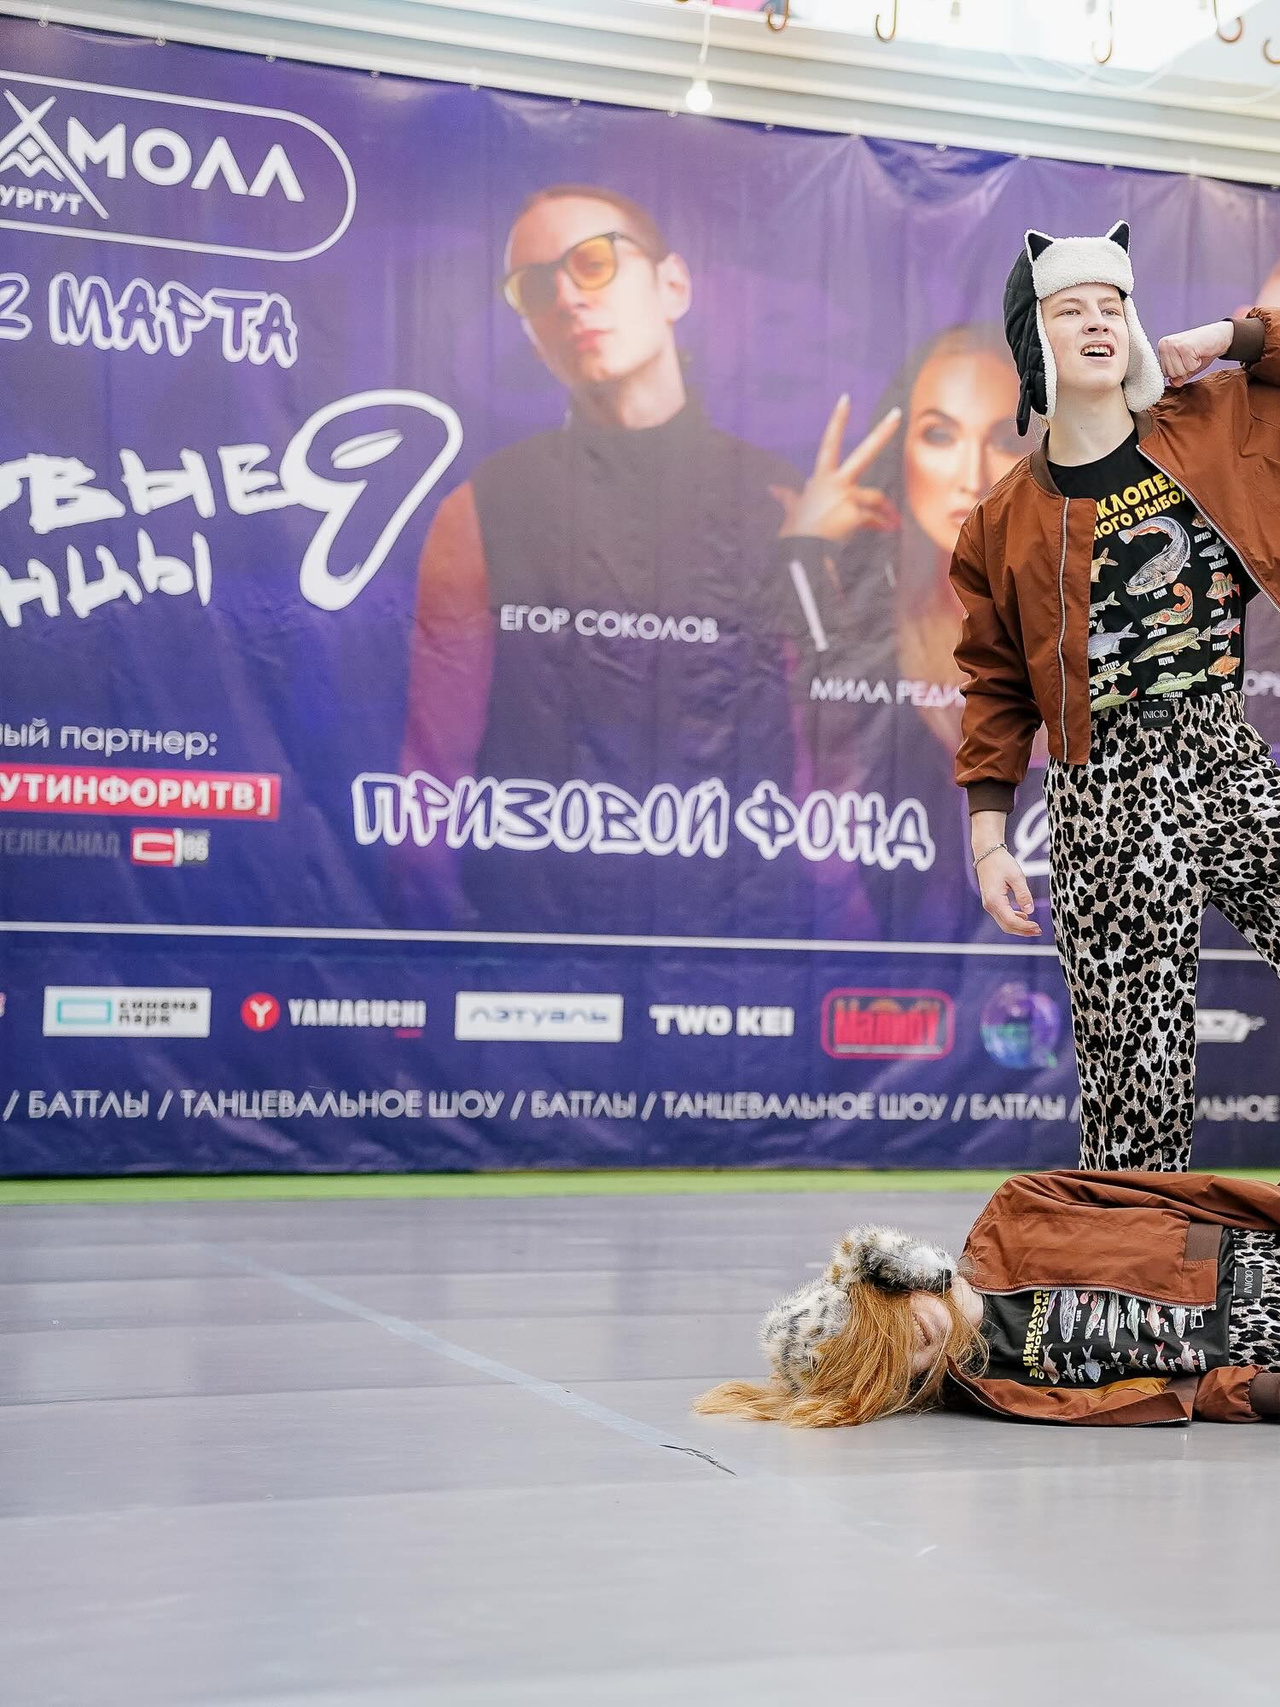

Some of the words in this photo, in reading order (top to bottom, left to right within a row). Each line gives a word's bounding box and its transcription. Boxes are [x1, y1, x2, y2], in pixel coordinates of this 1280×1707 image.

[67, 115, 305, 202] МОЛЛ
[48, 271, 299, 369] МАРТА
[1096, 472, 1176, 521] КЛОПЕ
[1152, 587, 1168, 600] СОМ
[500, 603, 571, 634] ЕГОР
[574, 608, 720, 644] СОКОЛОВ
[809, 675, 893, 705] МИЛА
[1142, 709, 1169, 720] INICIO
[0, 717, 50, 749] ый
[60, 725, 219, 762] партнер:
[352, 770, 730, 859] ПРИЗОВОЙ
[734, 778, 937, 871] ФОНД
[288, 998, 426, 1027] YAMAGUCHI
[649, 1005, 732, 1036] TWO
[28, 1090, 149, 1119] БАТТЛЫ
[181, 1090, 422, 1121] ТАНЦЕВАЛЬНОЕ
[429, 1090, 504, 1120] ШОУ
[530, 1090, 636, 1119] БАТТЛЫ
[661, 1091, 876, 1121] ТАНЦЕВАЛЬНОЕ
[878, 1092, 948, 1121] ШОУ
[970, 1093, 1066, 1121] БАТТЛЫ
[1022, 1290, 1042, 1378] ЭЦИКЛОП
